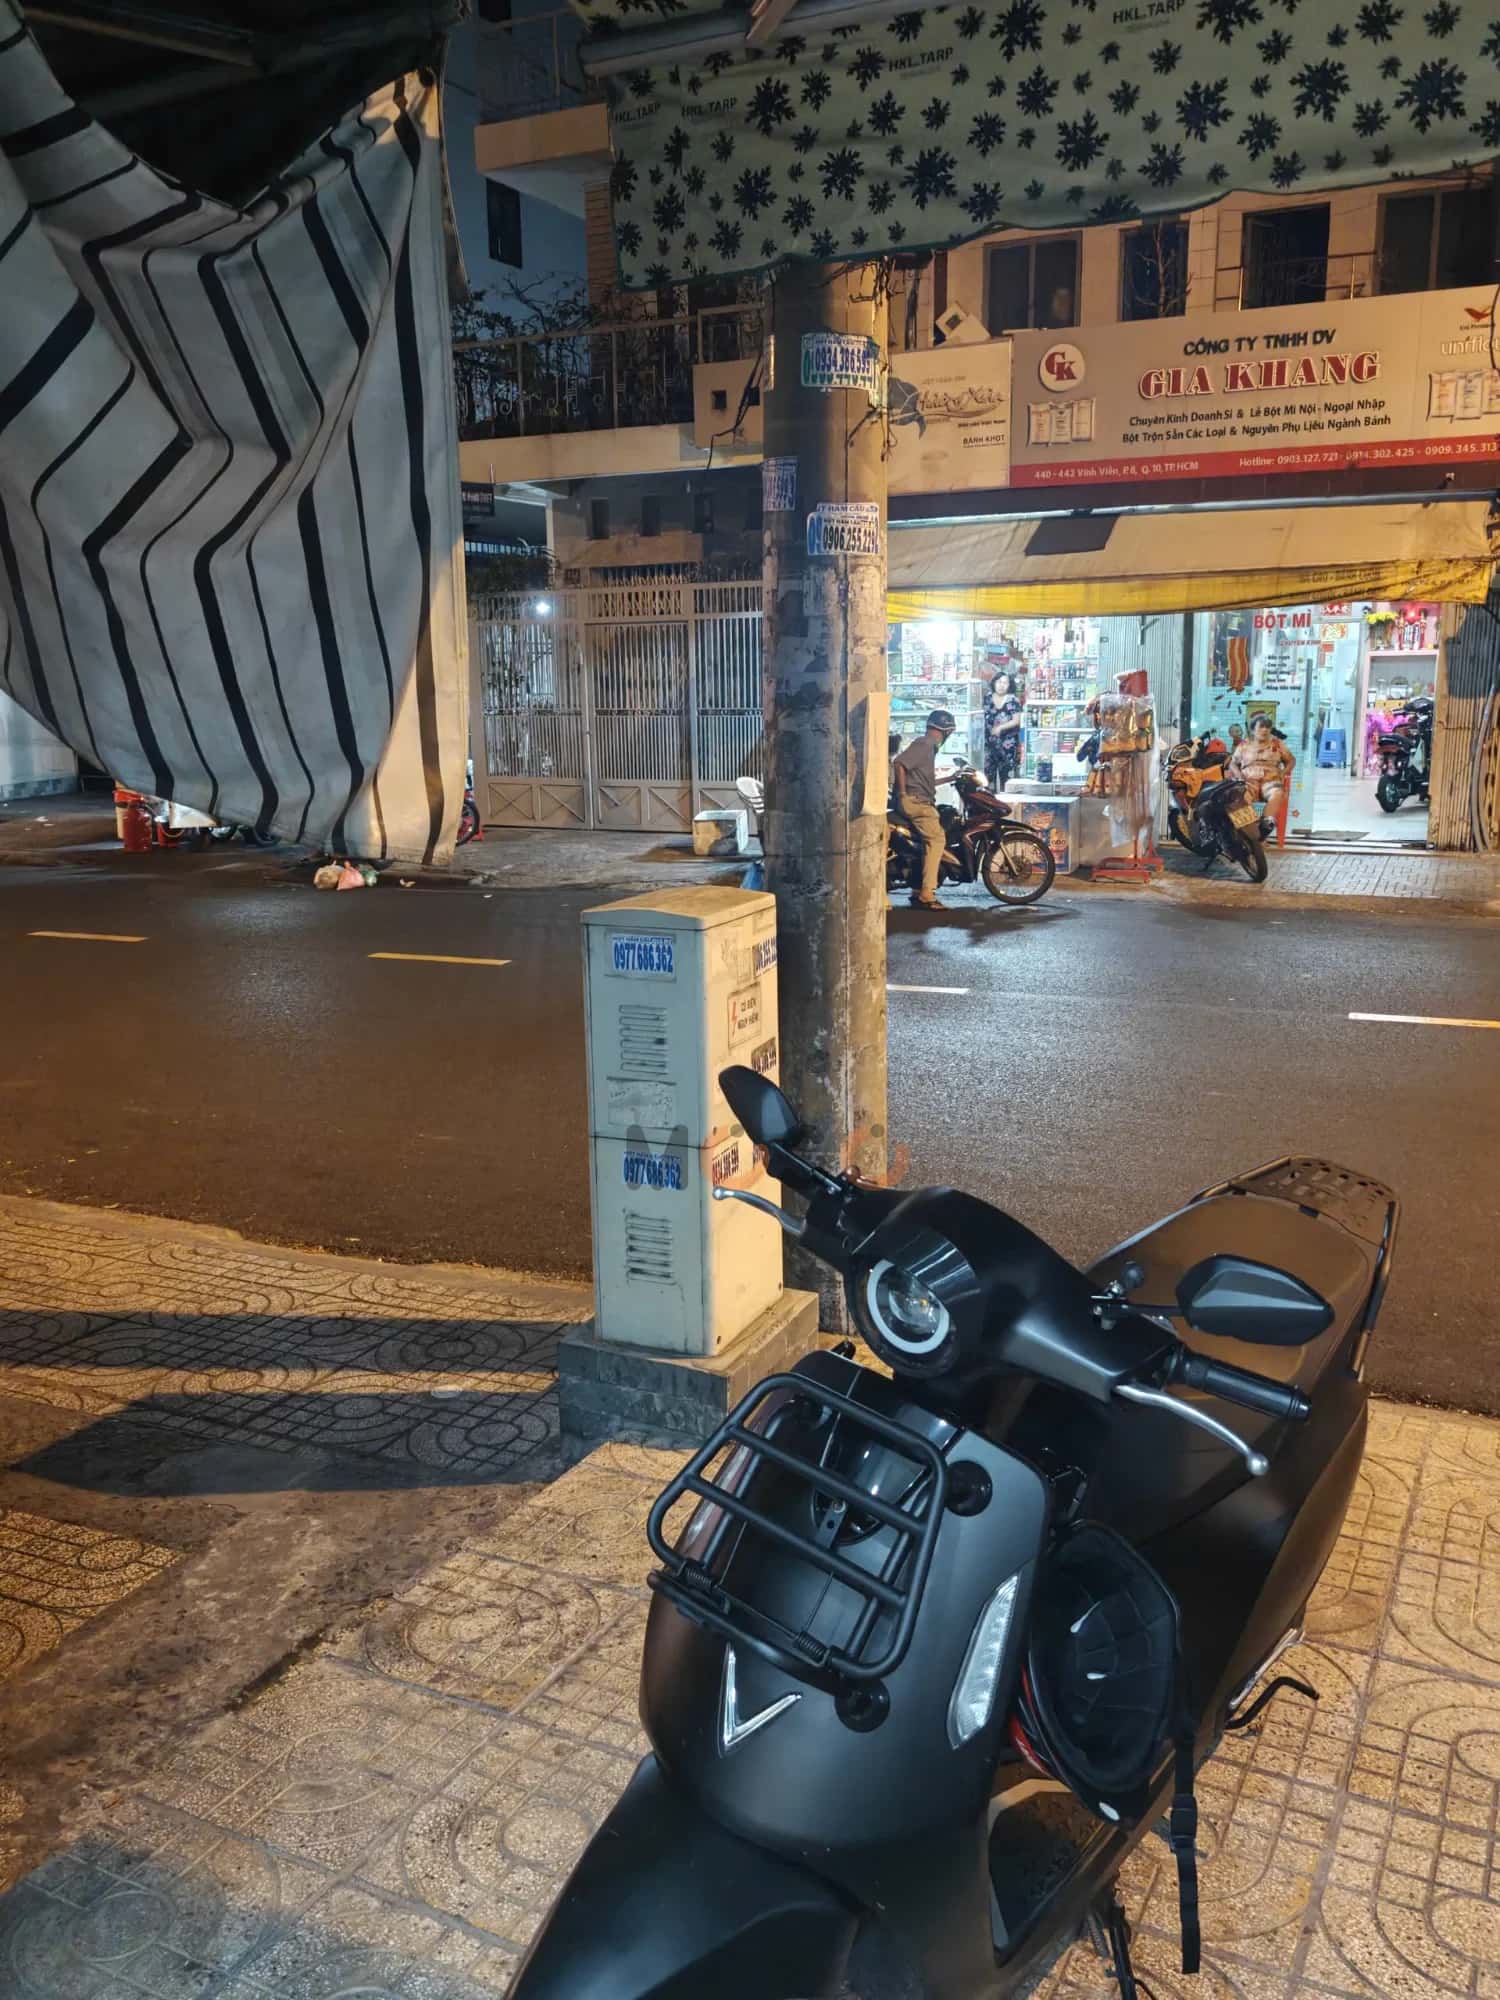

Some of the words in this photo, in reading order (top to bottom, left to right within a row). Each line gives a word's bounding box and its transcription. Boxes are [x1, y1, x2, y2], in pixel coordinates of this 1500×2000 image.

[1183, 337, 1229, 356] CÔNG
[1235, 336, 1258, 352] TY
[1263, 331, 1308, 349] TNHH
[1312, 328, 1336, 345] DV
[1139, 364, 1215, 400] GIA
[1223, 351, 1380, 397] KHANG
[1130, 415, 1165, 427] Chuyên
[1166, 412, 1188, 424] Kinh
[1191, 410, 1222, 422] Doanh
[1324, 401, 1354, 414] Ngoại
[1364, 414, 1391, 427] Bánh
[1254, 610, 1287, 633] BỘT
[1292, 608, 1312, 628] MÌ
